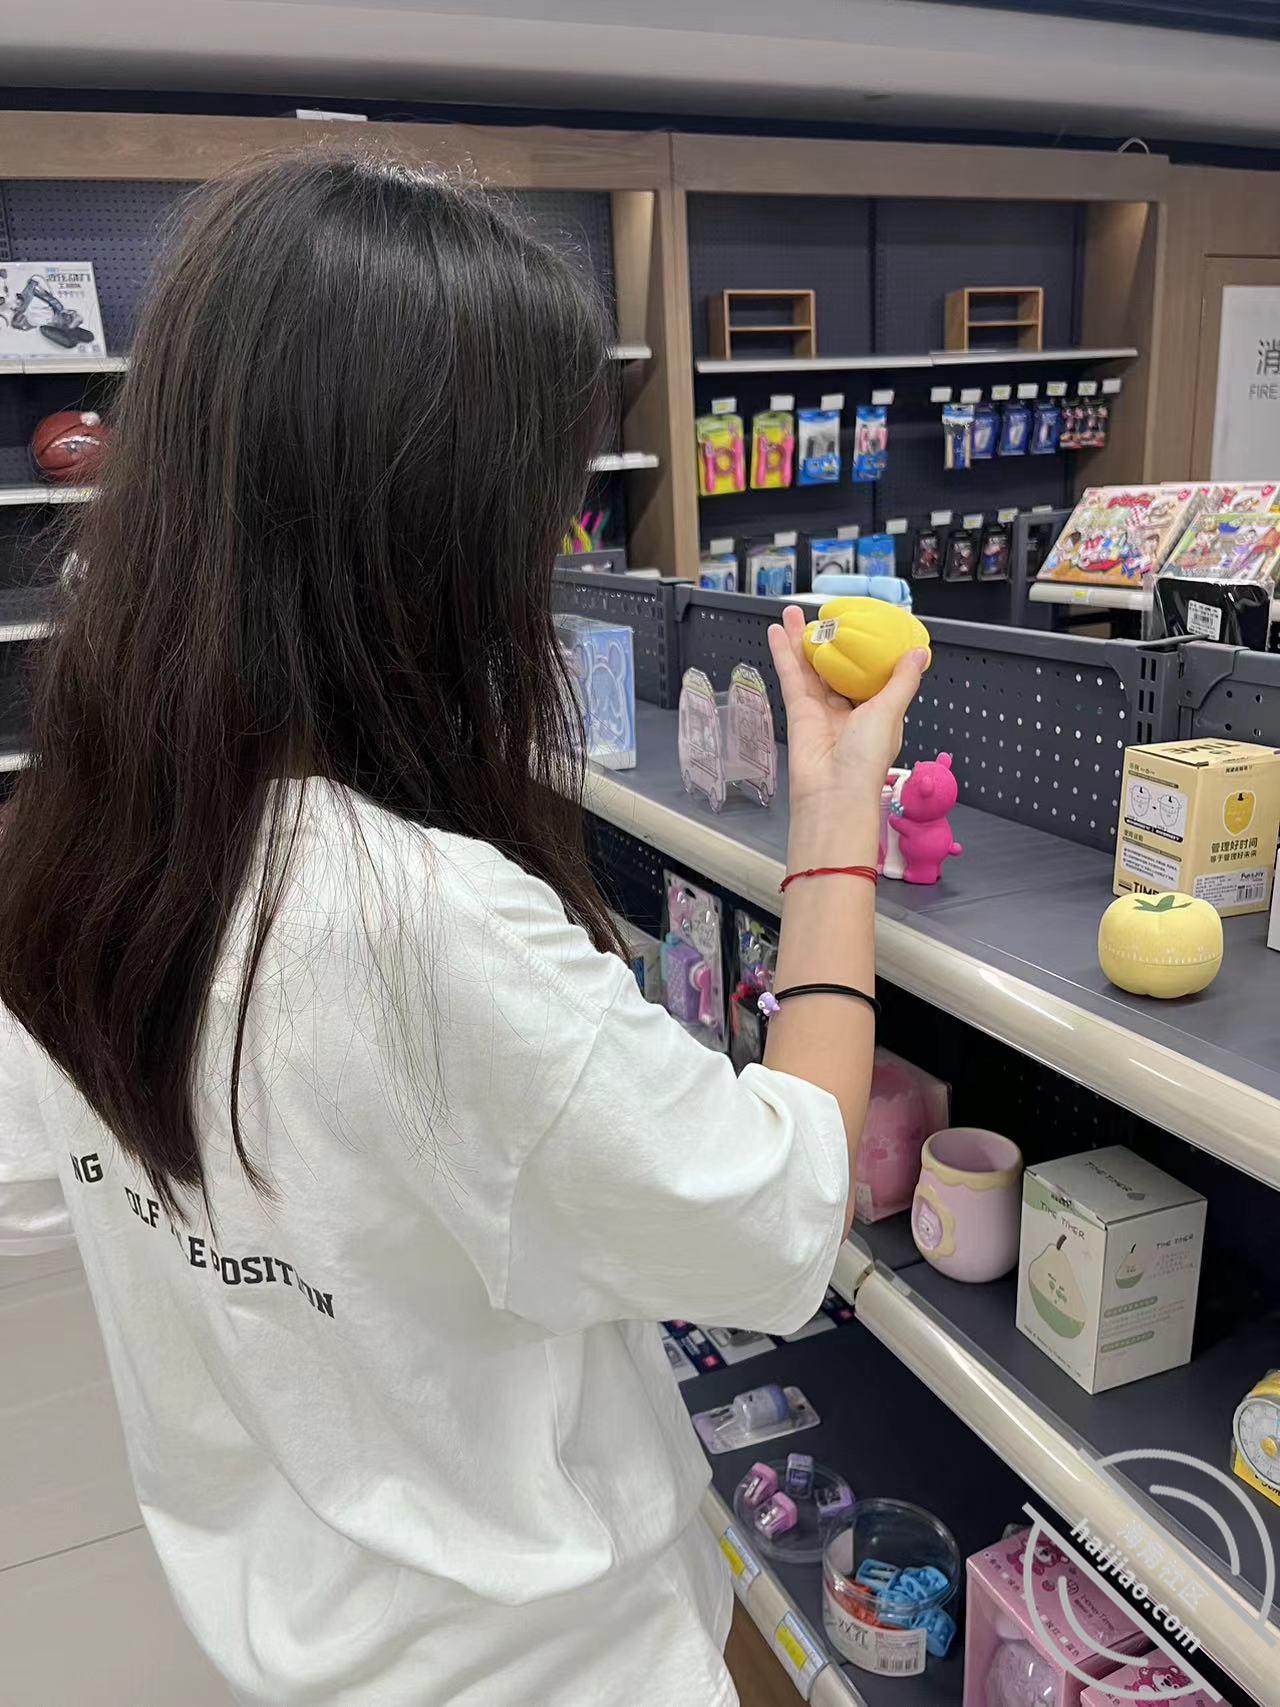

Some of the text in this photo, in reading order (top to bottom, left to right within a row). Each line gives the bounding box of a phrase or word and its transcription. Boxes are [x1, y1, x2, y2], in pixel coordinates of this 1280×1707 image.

[1211, 837, 1259, 854] 管理好时间
